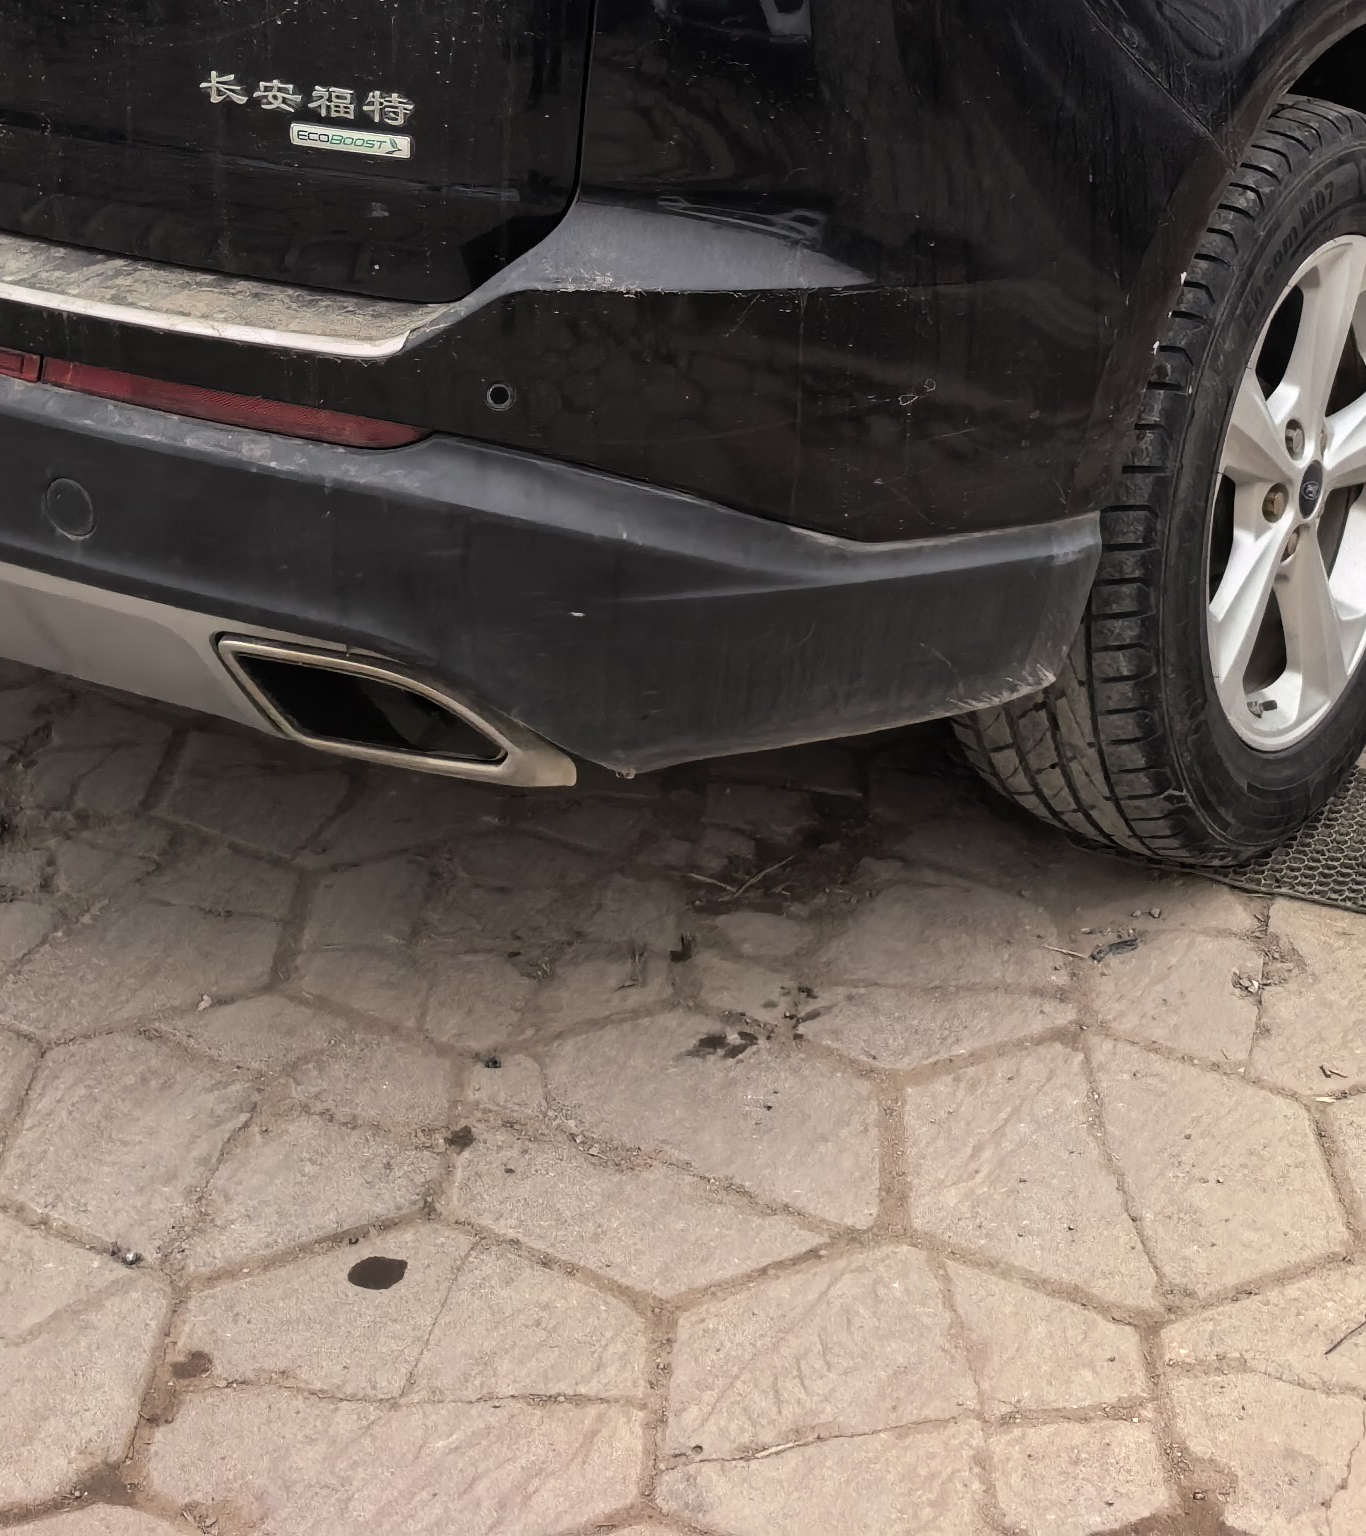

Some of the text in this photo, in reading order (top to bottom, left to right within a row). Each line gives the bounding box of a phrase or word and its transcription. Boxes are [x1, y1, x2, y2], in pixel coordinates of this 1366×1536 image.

[199, 70, 416, 126] 长安福特
[296, 129, 387, 150] ECOBOOST
